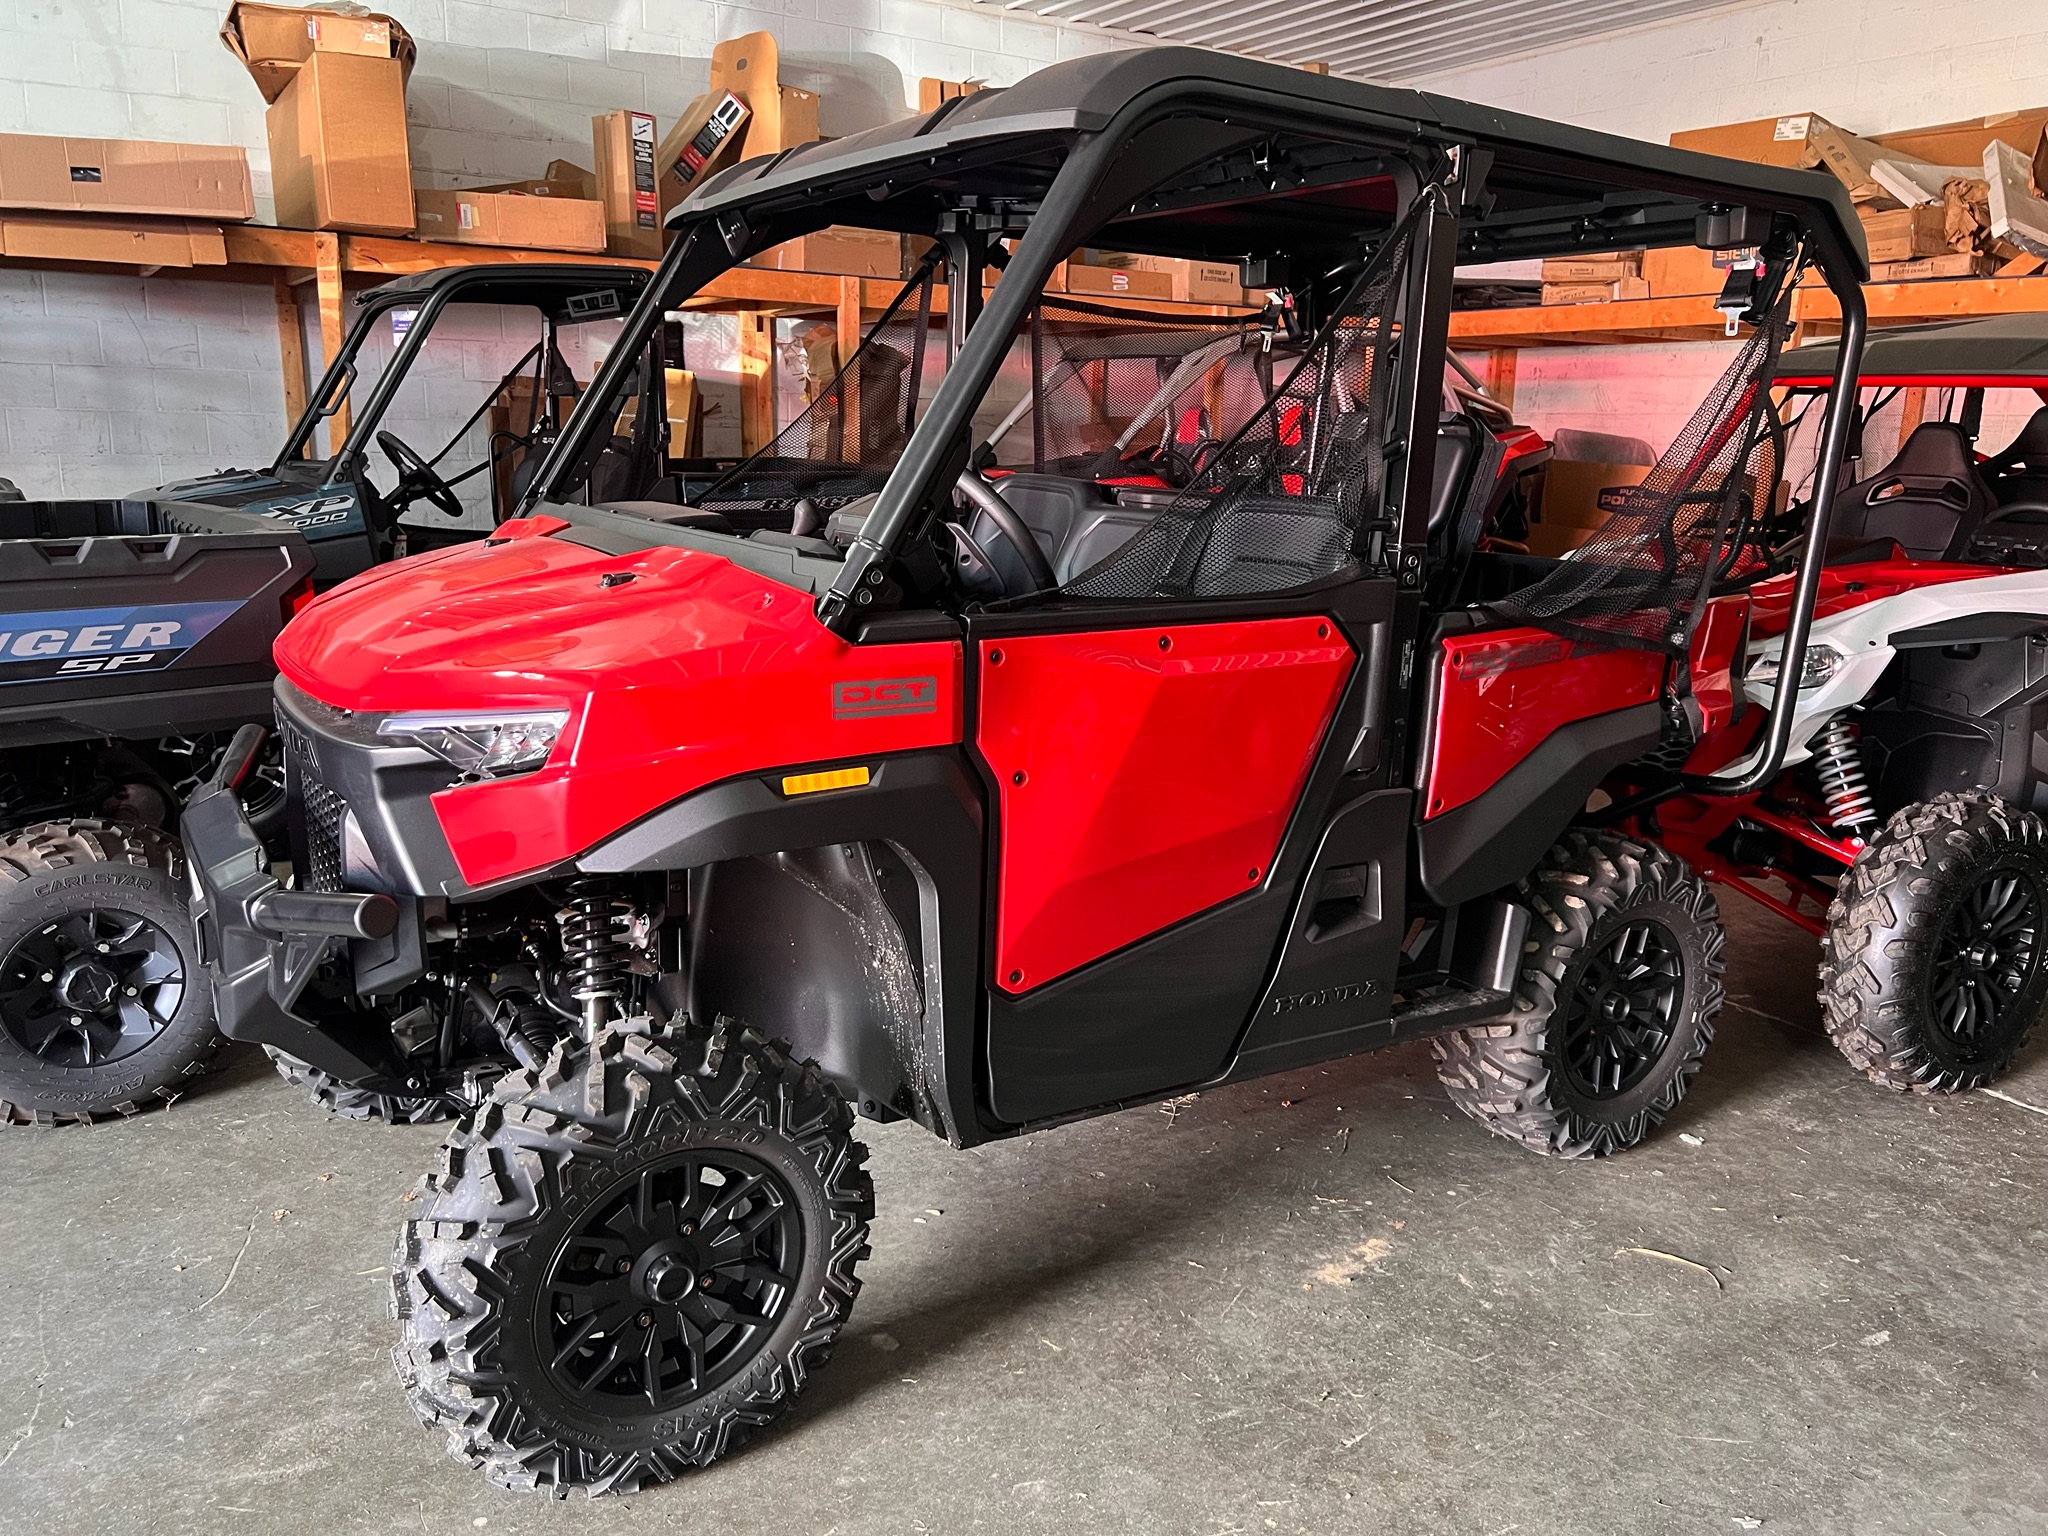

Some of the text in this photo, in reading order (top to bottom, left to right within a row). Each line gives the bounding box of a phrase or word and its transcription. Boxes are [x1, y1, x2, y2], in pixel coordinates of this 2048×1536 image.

[260, 495, 356, 520] XP
[289, 512, 348, 529] 000
[55, 653, 156, 674] SP
[841, 682, 929, 703] DCT
[33, 873, 153, 898] CARLSTAR
[1272, 980, 1378, 1015] HONDA
